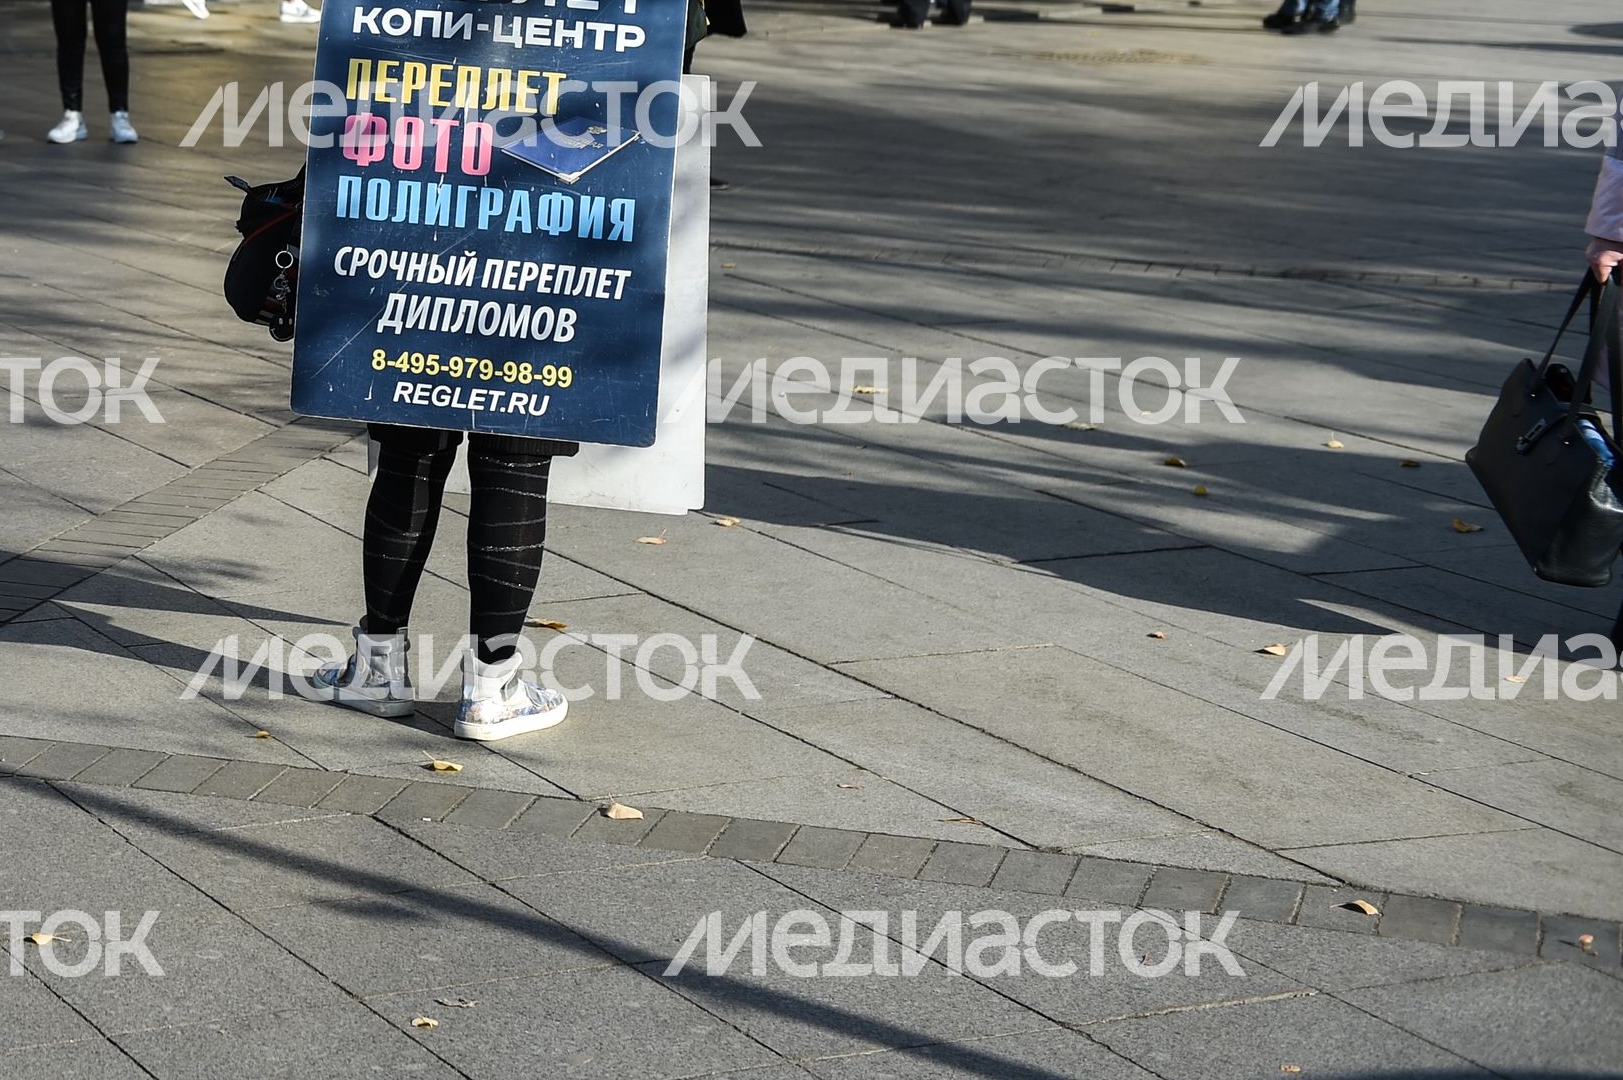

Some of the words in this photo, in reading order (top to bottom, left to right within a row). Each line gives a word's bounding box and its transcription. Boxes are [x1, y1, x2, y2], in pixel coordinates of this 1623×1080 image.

[352, 6, 646, 53] КОПИ-ЦЕНТР
[345, 58, 567, 115] ПЕРЕПЛЕТ
[342, 112, 495, 176] ФОТО
[336, 175, 636, 243] ПОЛИГРАФИЯ
[333, 246, 478, 288] СРОЧНЫЙ
[480, 258, 632, 301] ПЕРЕПЛЕТ
[376, 292, 577, 343] ДИПЛОМОВ
[371, 349, 573, 388] 8-495-979-98-99
[392, 381, 550, 417] REGLET.RU
